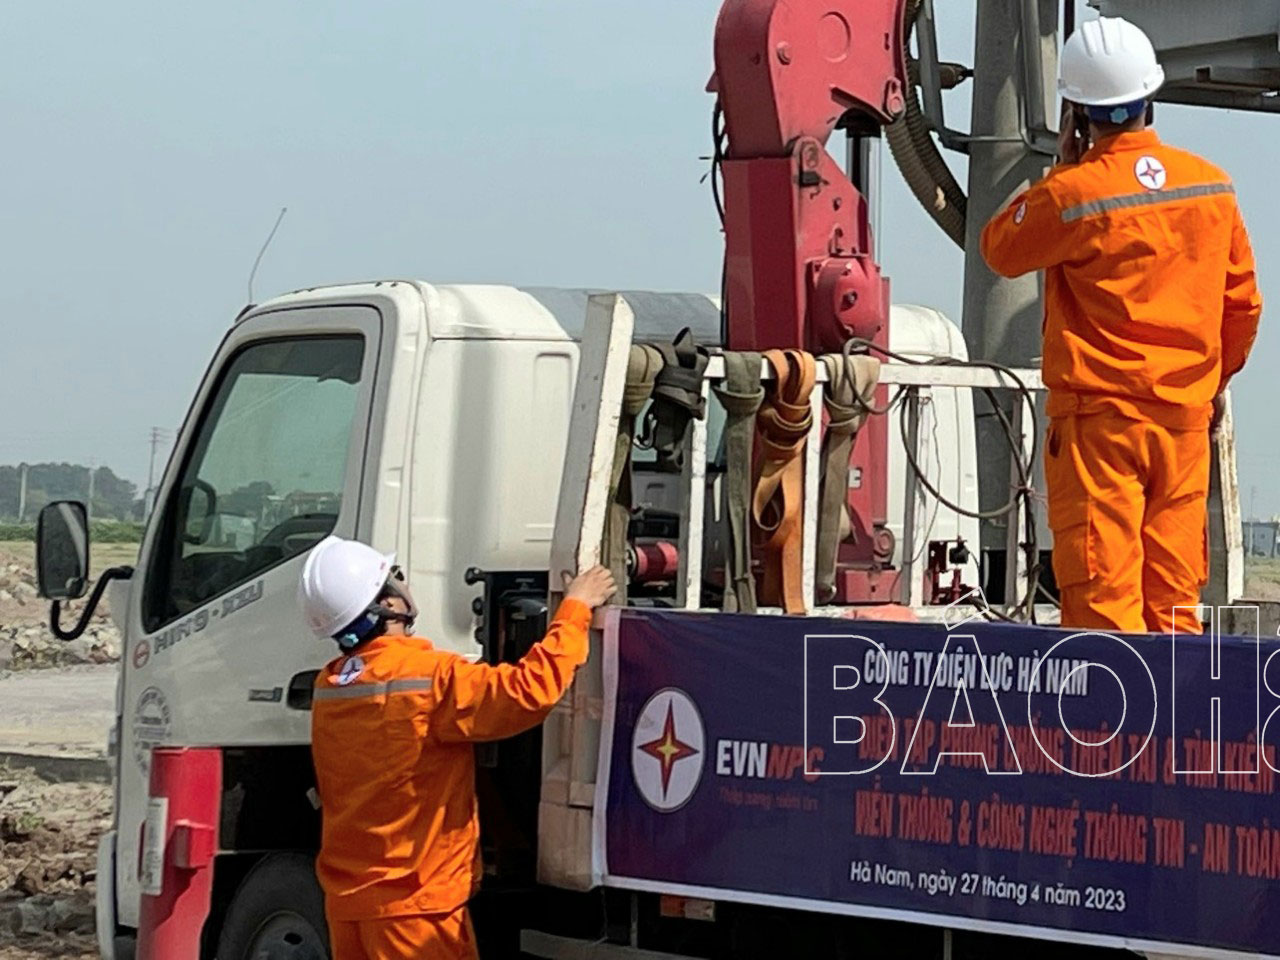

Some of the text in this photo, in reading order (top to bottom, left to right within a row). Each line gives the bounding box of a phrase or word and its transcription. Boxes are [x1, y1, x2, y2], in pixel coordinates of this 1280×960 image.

[863, 642, 1089, 698] CÔNG TY ĐIỆN LỰC HÀ NAM
[1128, 732, 1158, 784] TAI
[1163, 737, 1177, 786] &
[898, 787, 953, 844] THÔNG
[957, 800, 972, 846] &
[977, 793, 1025, 851] CÔNG
[1029, 799, 1080, 868] NGHỆ
[1083, 803, 1147, 864] THÔNG
[1153, 818, 1185, 868] TIN
[1202, 823, 1230, 874] AN
[850, 861, 1126, 912] Hà Nam, ngày 27 tháng 4 năm 2023
